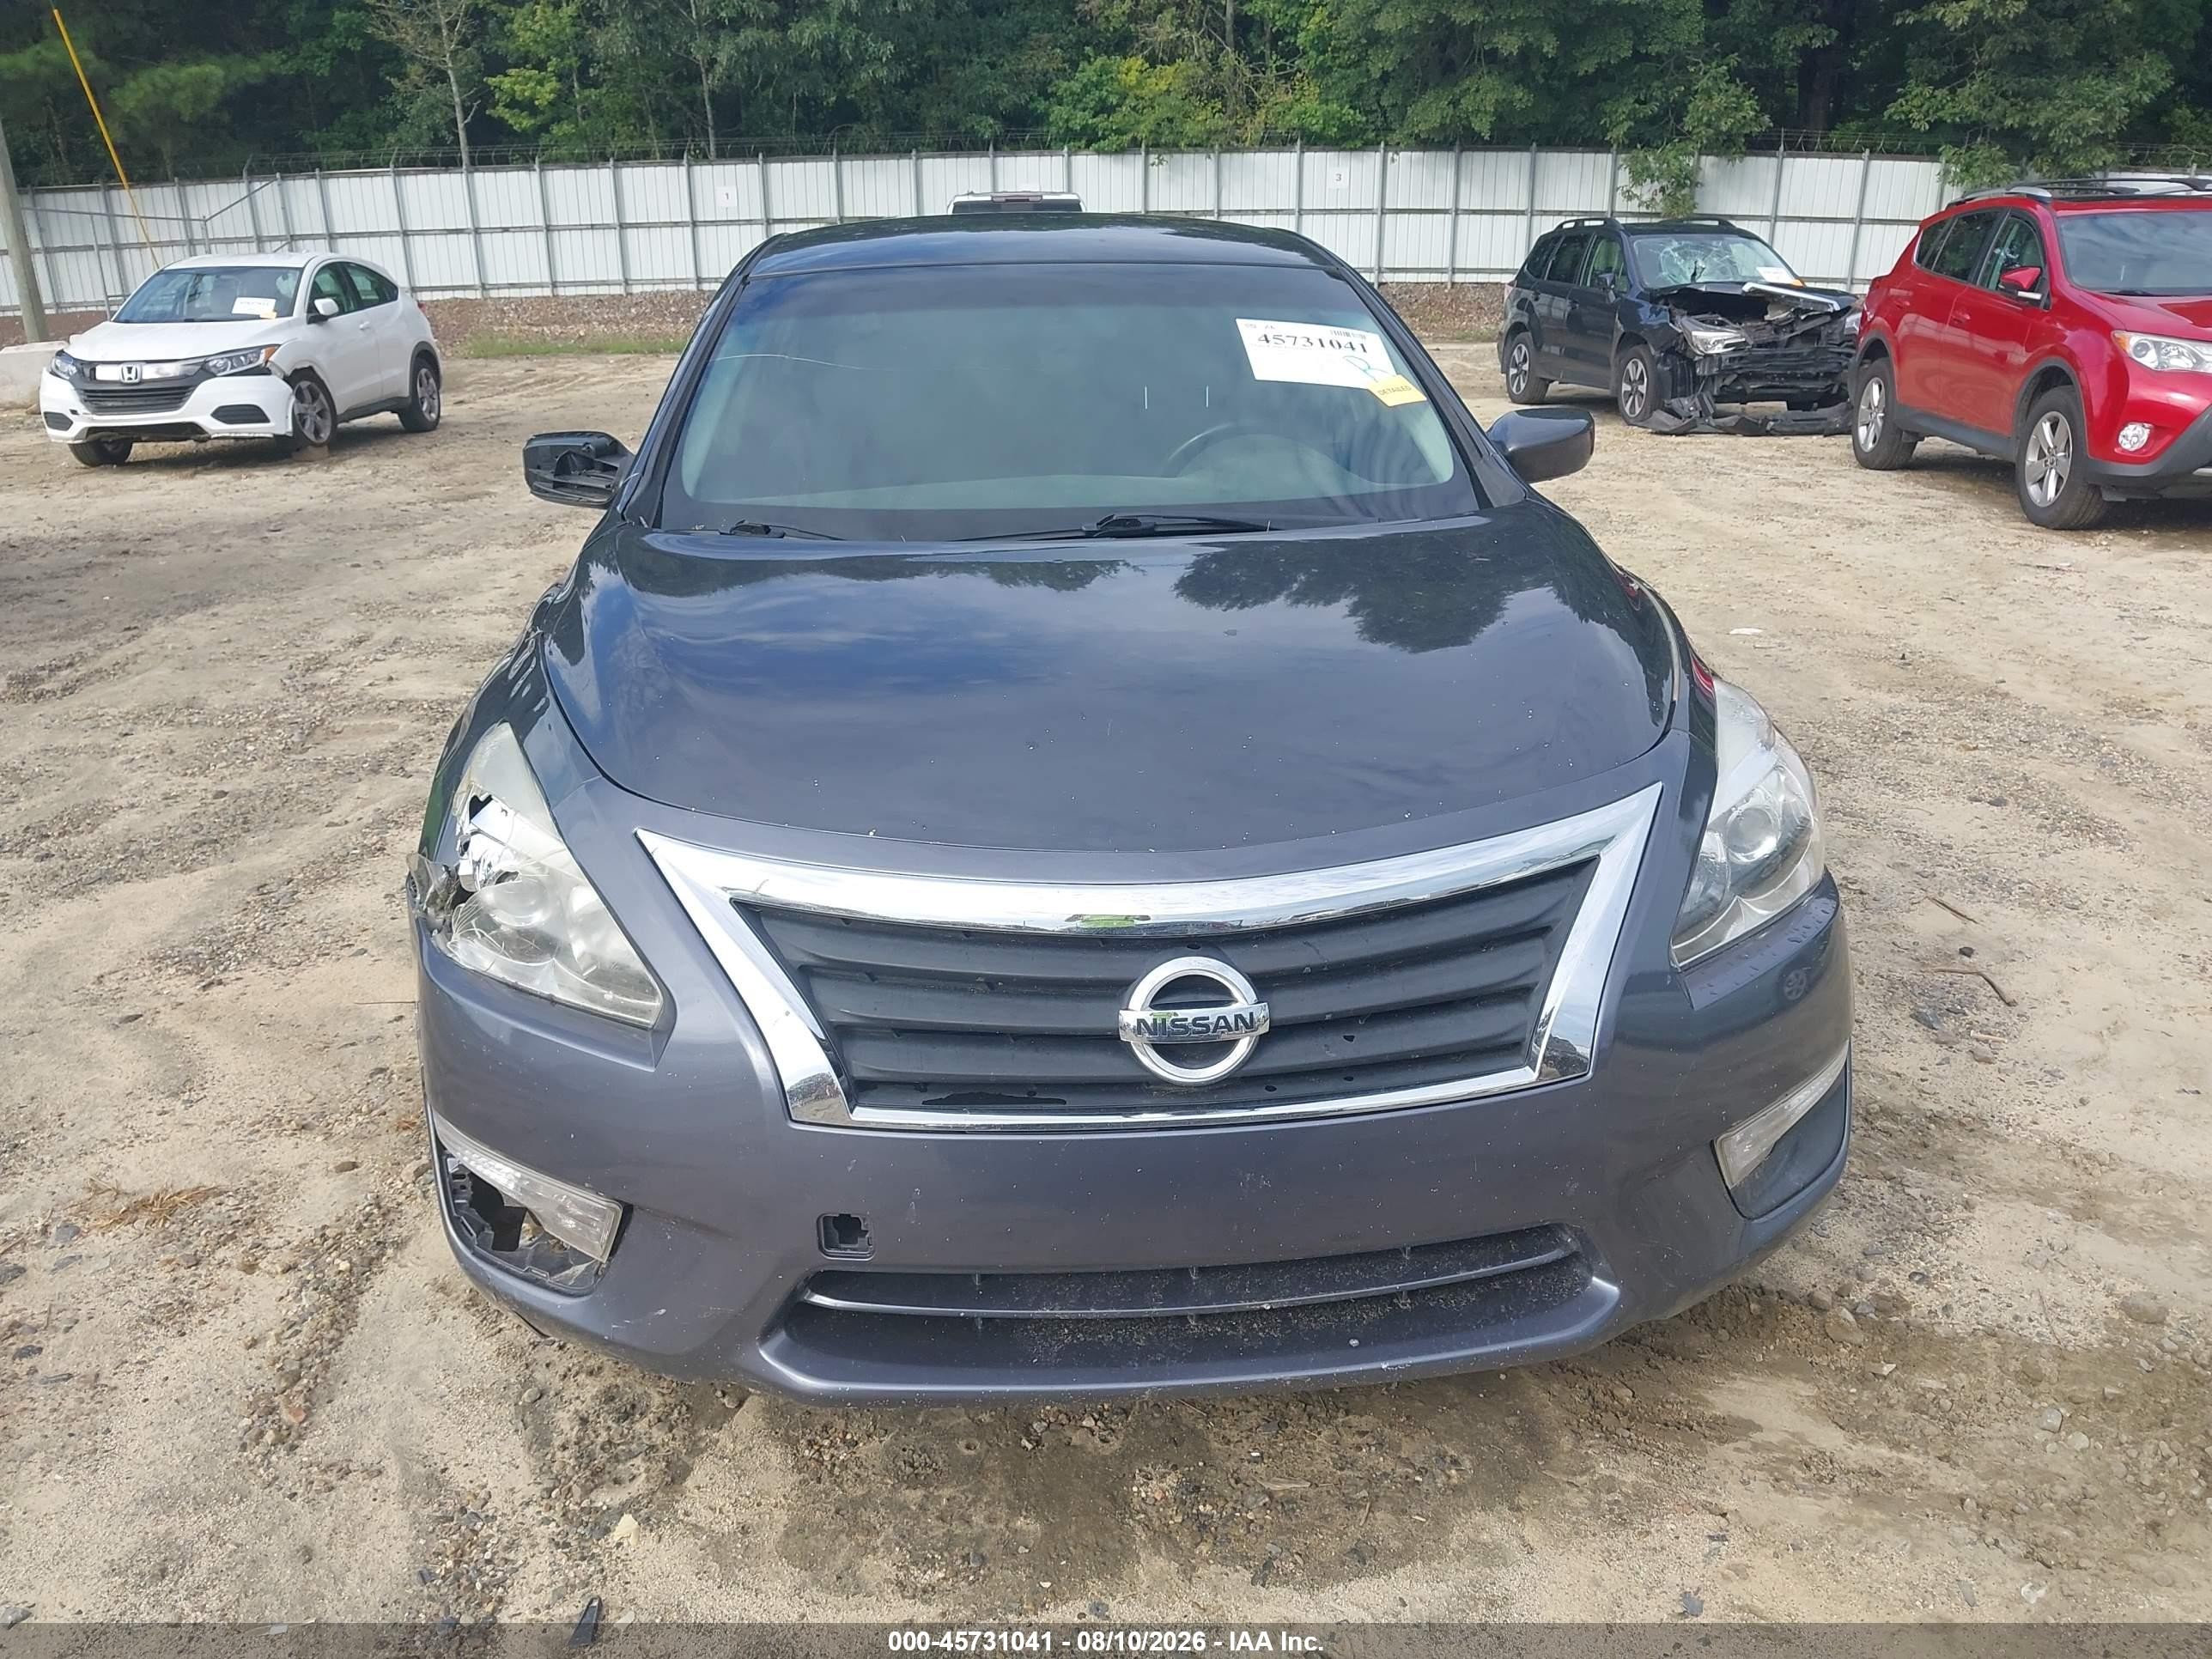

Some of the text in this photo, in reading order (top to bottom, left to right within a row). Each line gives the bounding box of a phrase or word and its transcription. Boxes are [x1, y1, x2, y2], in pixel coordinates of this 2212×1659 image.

[1257, 333, 1368, 354] 45731041
[1377, 385, 1413, 397] DETAILED
[1136, 1011, 1255, 1037] NISSAN
